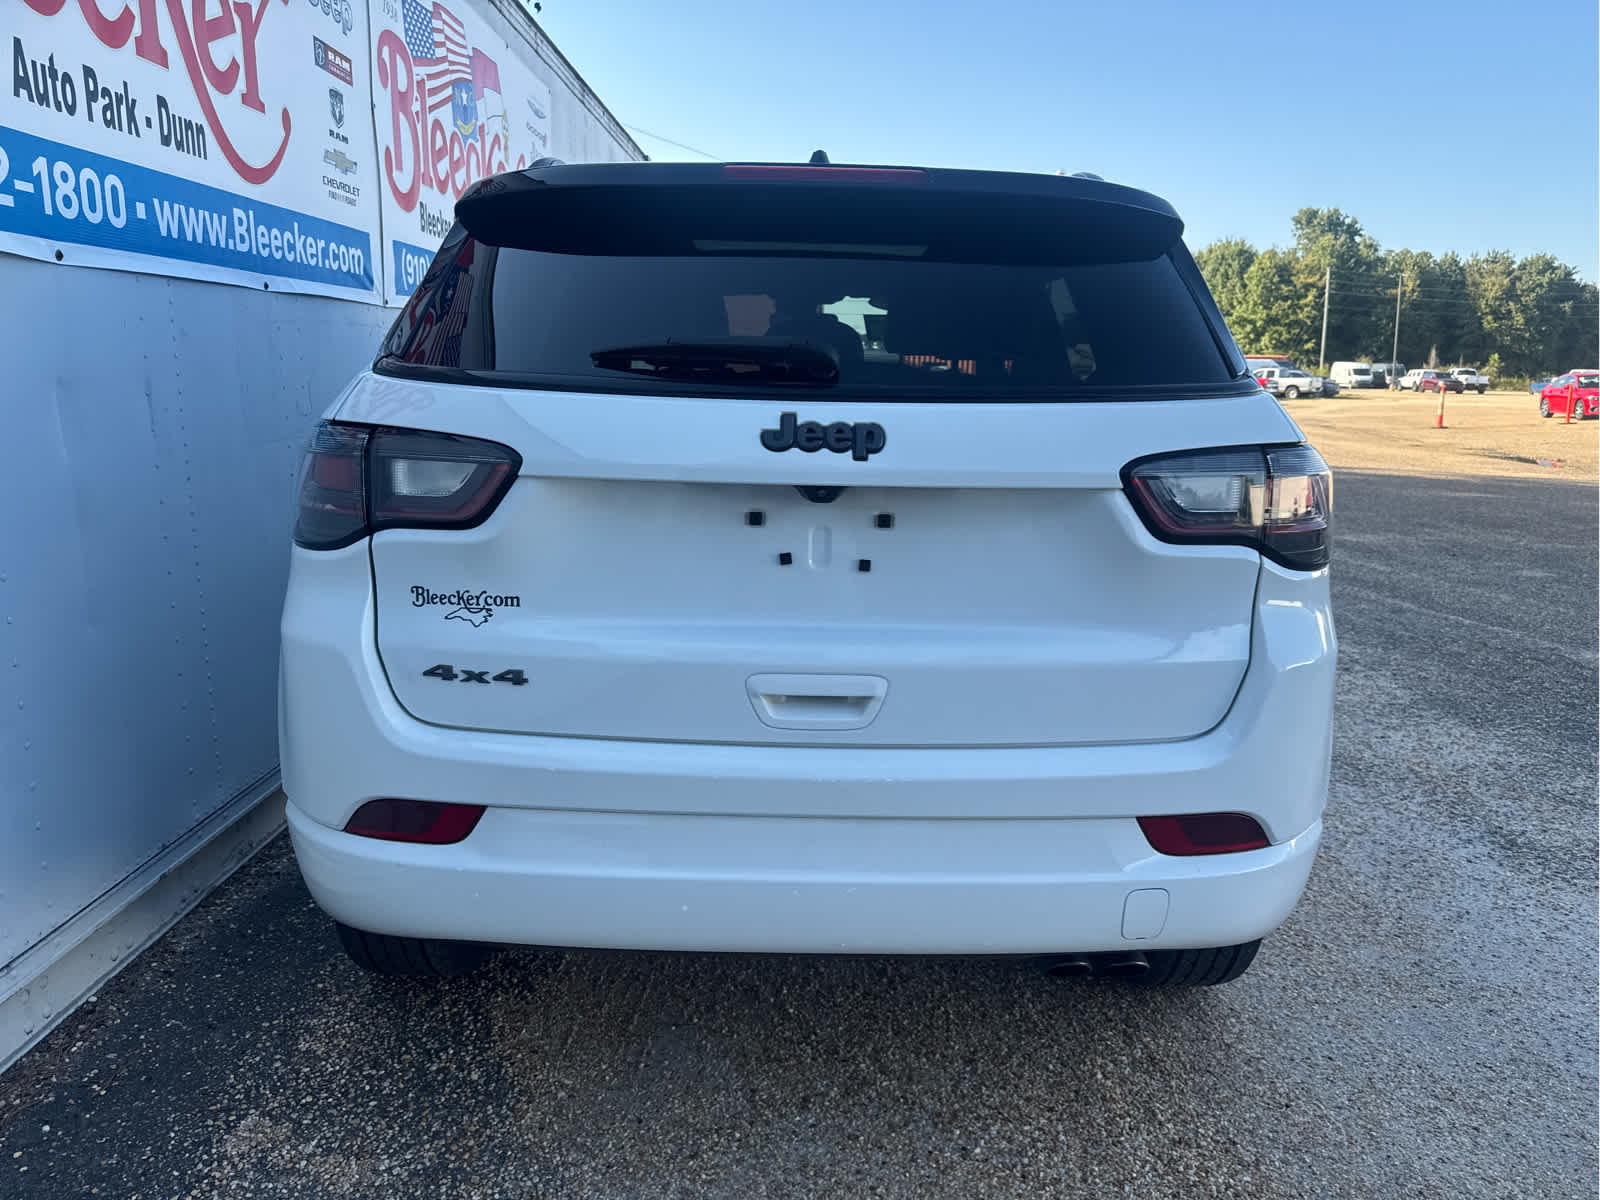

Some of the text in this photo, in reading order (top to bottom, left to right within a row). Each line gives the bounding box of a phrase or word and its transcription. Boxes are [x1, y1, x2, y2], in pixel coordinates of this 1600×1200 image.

[13, 36, 77, 116] Auto
[82, 64, 141, 138] Park
[156, 94, 208, 161] Dunn
[328, 128, 349, 145] RAM
[375, 28, 526, 213] Bleeck
[322, 175, 361, 199] CHEVROLET
[152, 198, 365, 276] www.Bleecker.com
[760, 411, 887, 462] Jeep
[410, 585, 521, 614] Bleecker.com
[422, 664, 529, 686] 4x4
